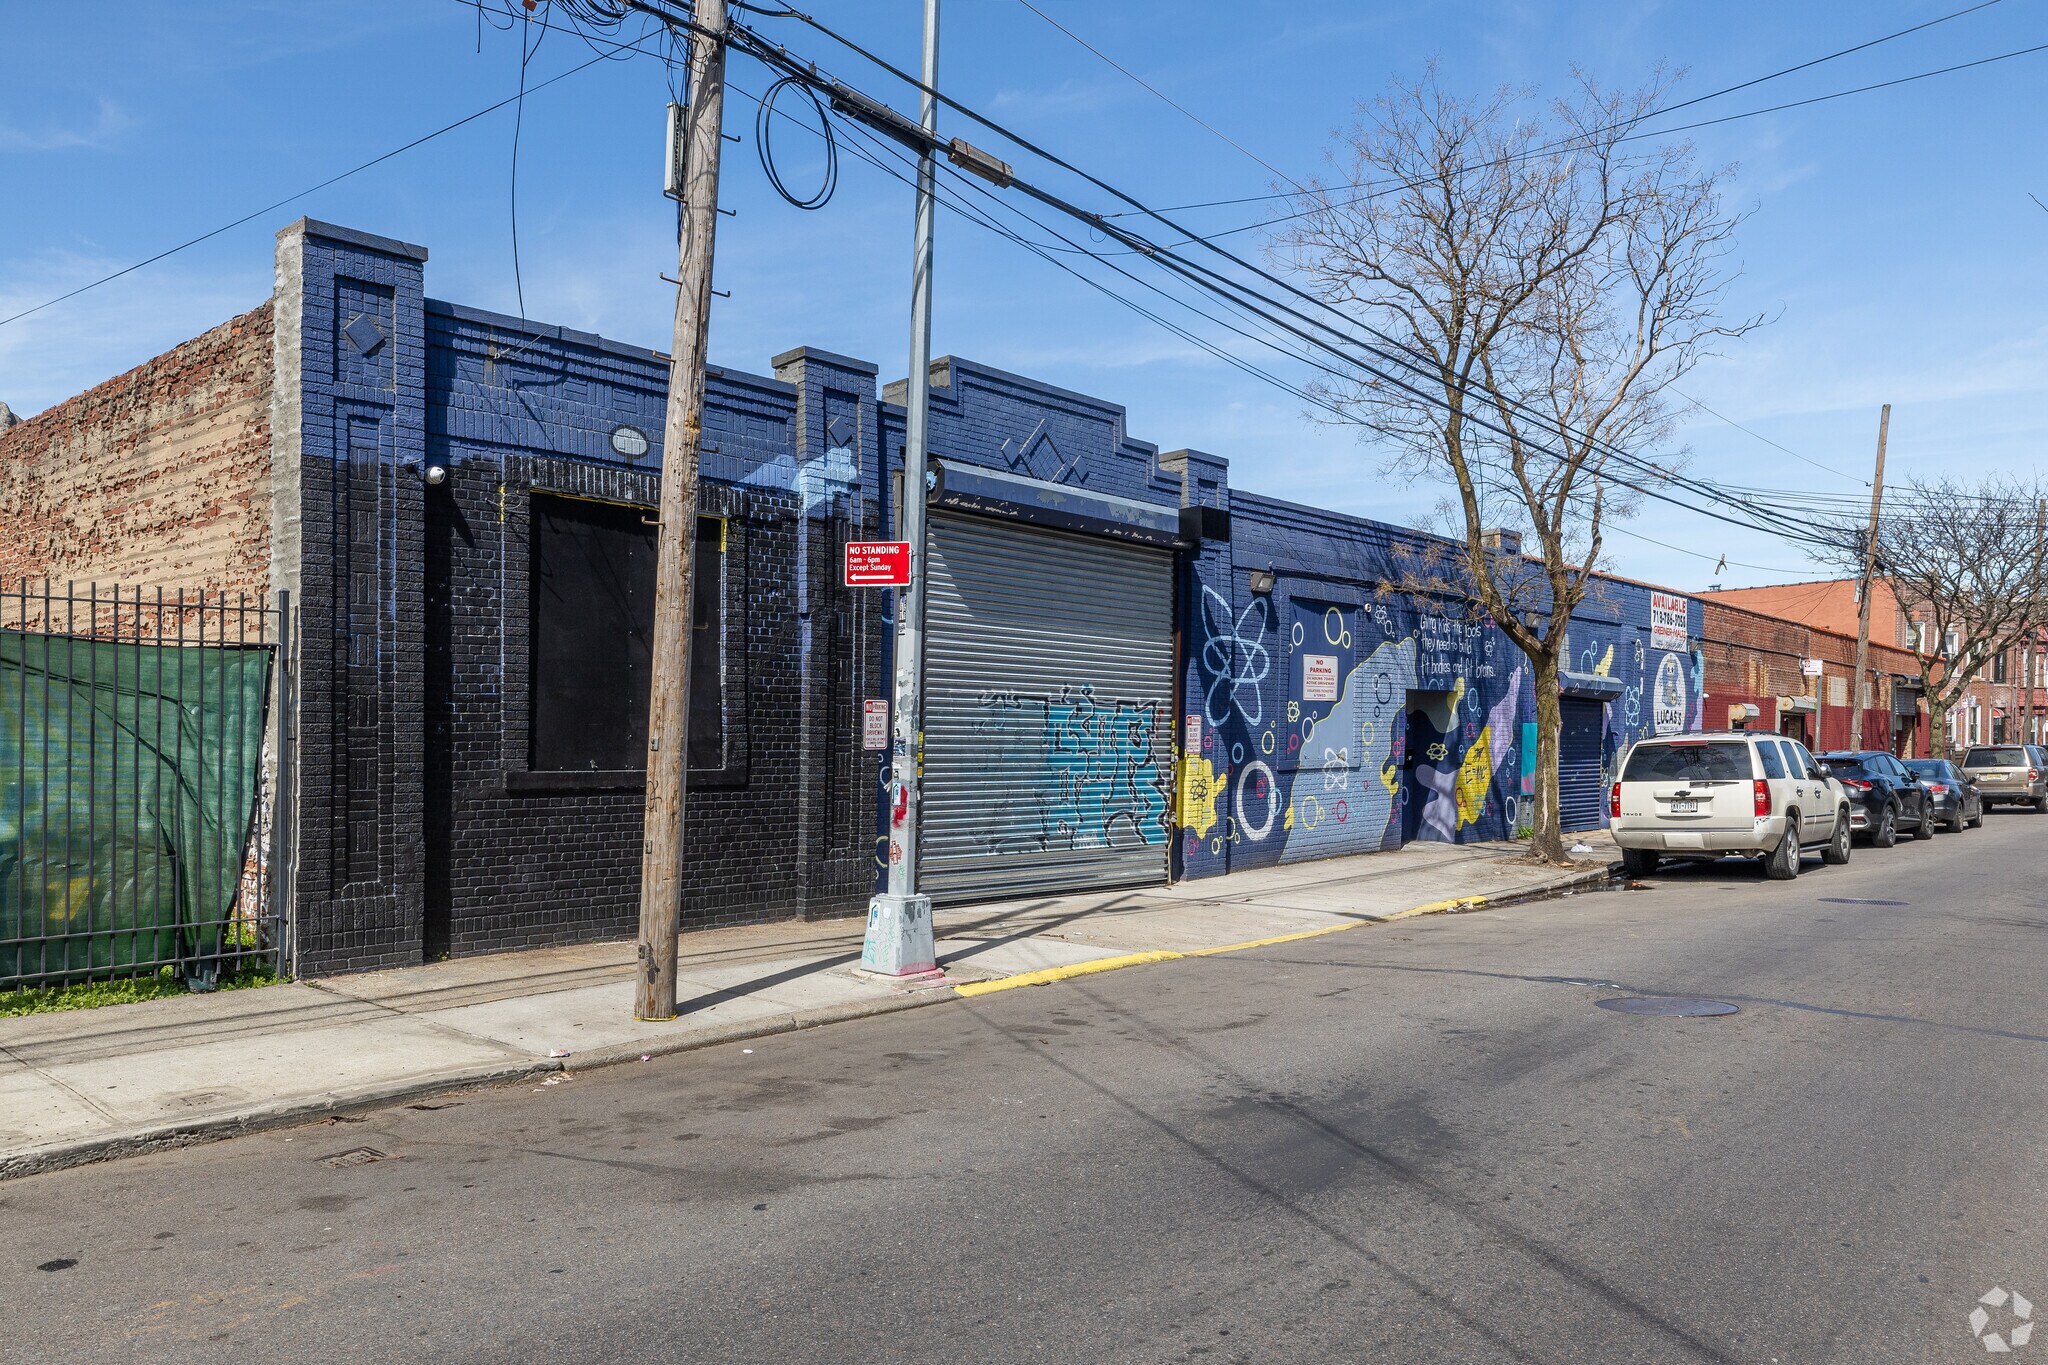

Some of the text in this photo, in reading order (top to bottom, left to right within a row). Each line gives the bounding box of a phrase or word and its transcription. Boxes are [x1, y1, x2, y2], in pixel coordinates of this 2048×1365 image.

[849, 546, 900, 555] NO STANDING
[867, 556, 880, 564] 6pm
[849, 564, 892, 572] Except Sunday
[1652, 594, 1687, 613] AVAILABLE
[1420, 632, 1472, 654] they need to build
[1420, 653, 1430, 678] fit
[1431, 653, 1451, 674] bodies
[1452, 657, 1463, 674] and
[1465, 657, 1474, 680] fit
